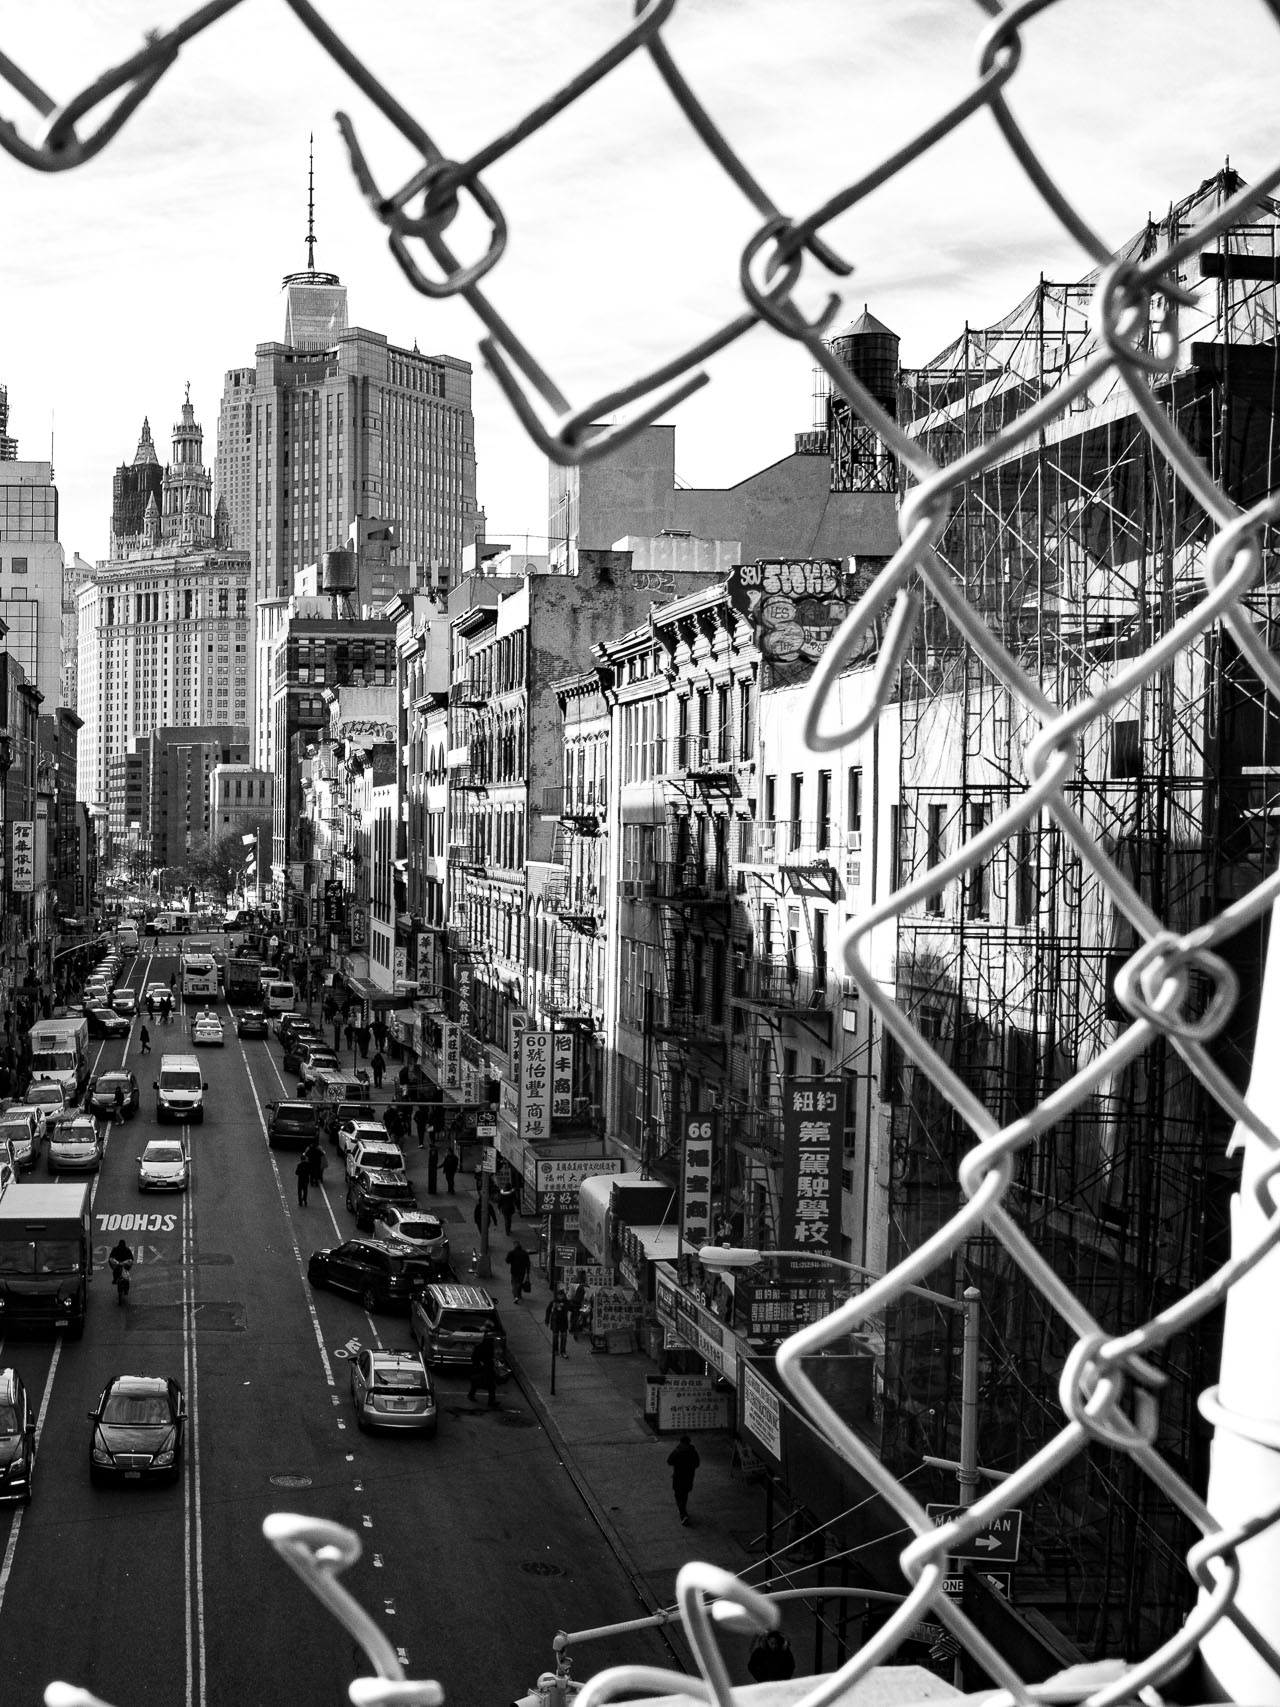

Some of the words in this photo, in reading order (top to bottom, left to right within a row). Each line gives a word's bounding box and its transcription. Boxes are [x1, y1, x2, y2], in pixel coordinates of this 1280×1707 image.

[688, 1122, 712, 1138] 66
[793, 1121, 831, 1244] 第一駕駛學校
[96, 1214, 177, 1231] SCHOOL
[935, 1514, 1011, 1532] MATAN
[942, 1581, 963, 1591] ONE
